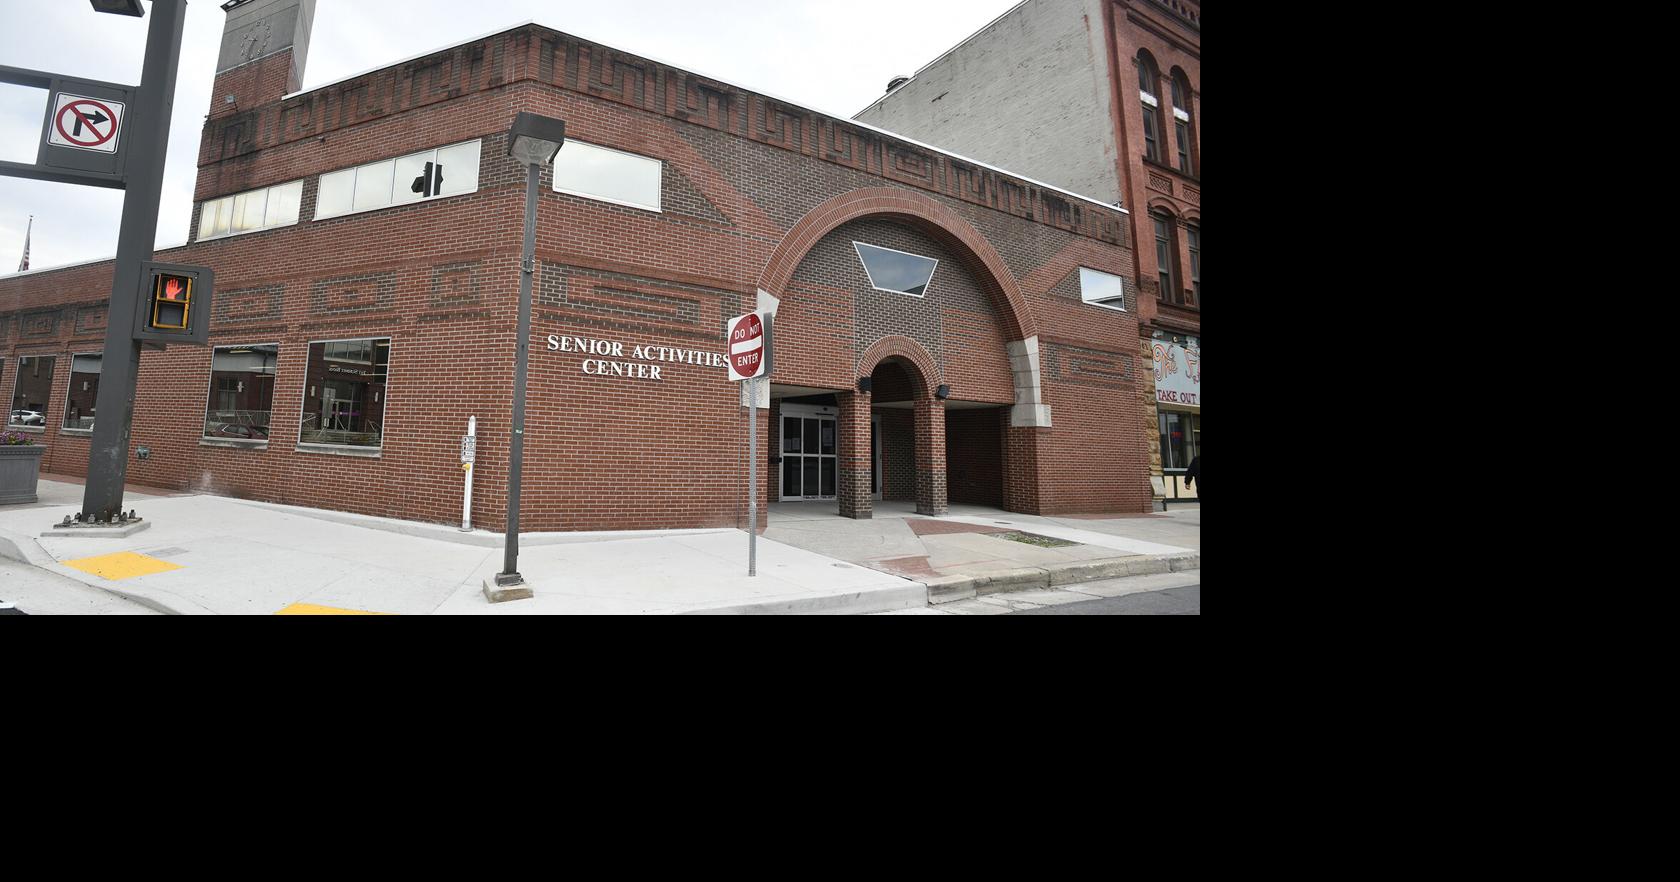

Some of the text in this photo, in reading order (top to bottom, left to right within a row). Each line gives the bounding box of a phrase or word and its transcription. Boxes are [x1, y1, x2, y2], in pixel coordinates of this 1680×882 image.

[734, 322, 760, 340] DO NOT
[547, 334, 729, 369] SENIOR ACTIVITIES
[737, 352, 759, 367] ENTER
[582, 358, 662, 381] CENTER
[1156, 389, 1197, 405] TAKE OUT
